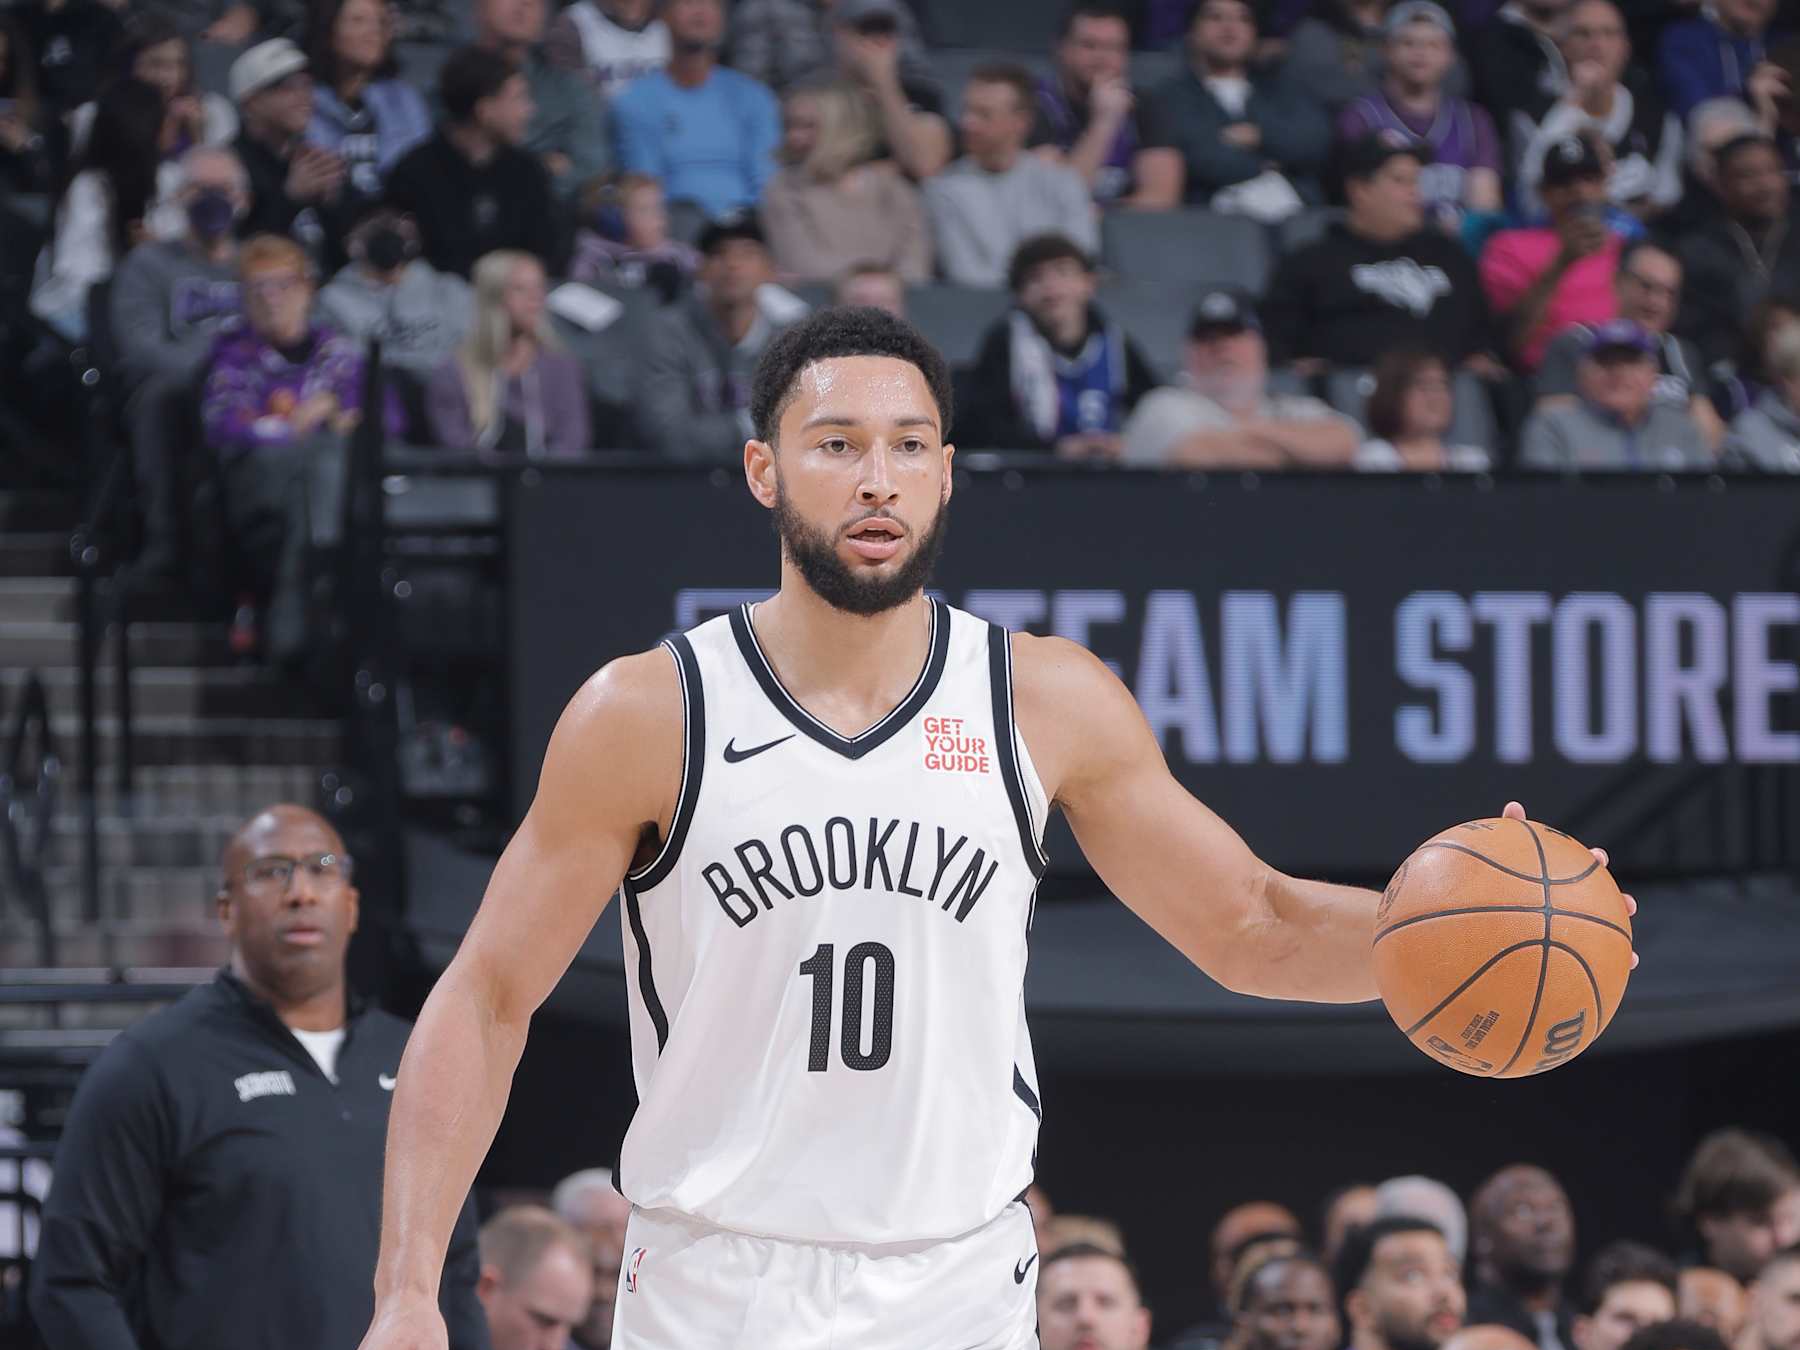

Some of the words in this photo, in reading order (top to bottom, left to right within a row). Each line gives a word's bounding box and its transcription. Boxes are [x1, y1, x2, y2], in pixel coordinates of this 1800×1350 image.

[1394, 590, 1800, 764] STORE
[924, 717, 964, 735] GET
[925, 735, 986, 755] YOUR
[925, 753, 990, 774] GUIDE
[702, 816, 998, 928] BROOKLYN
[799, 941, 895, 1073] 10
